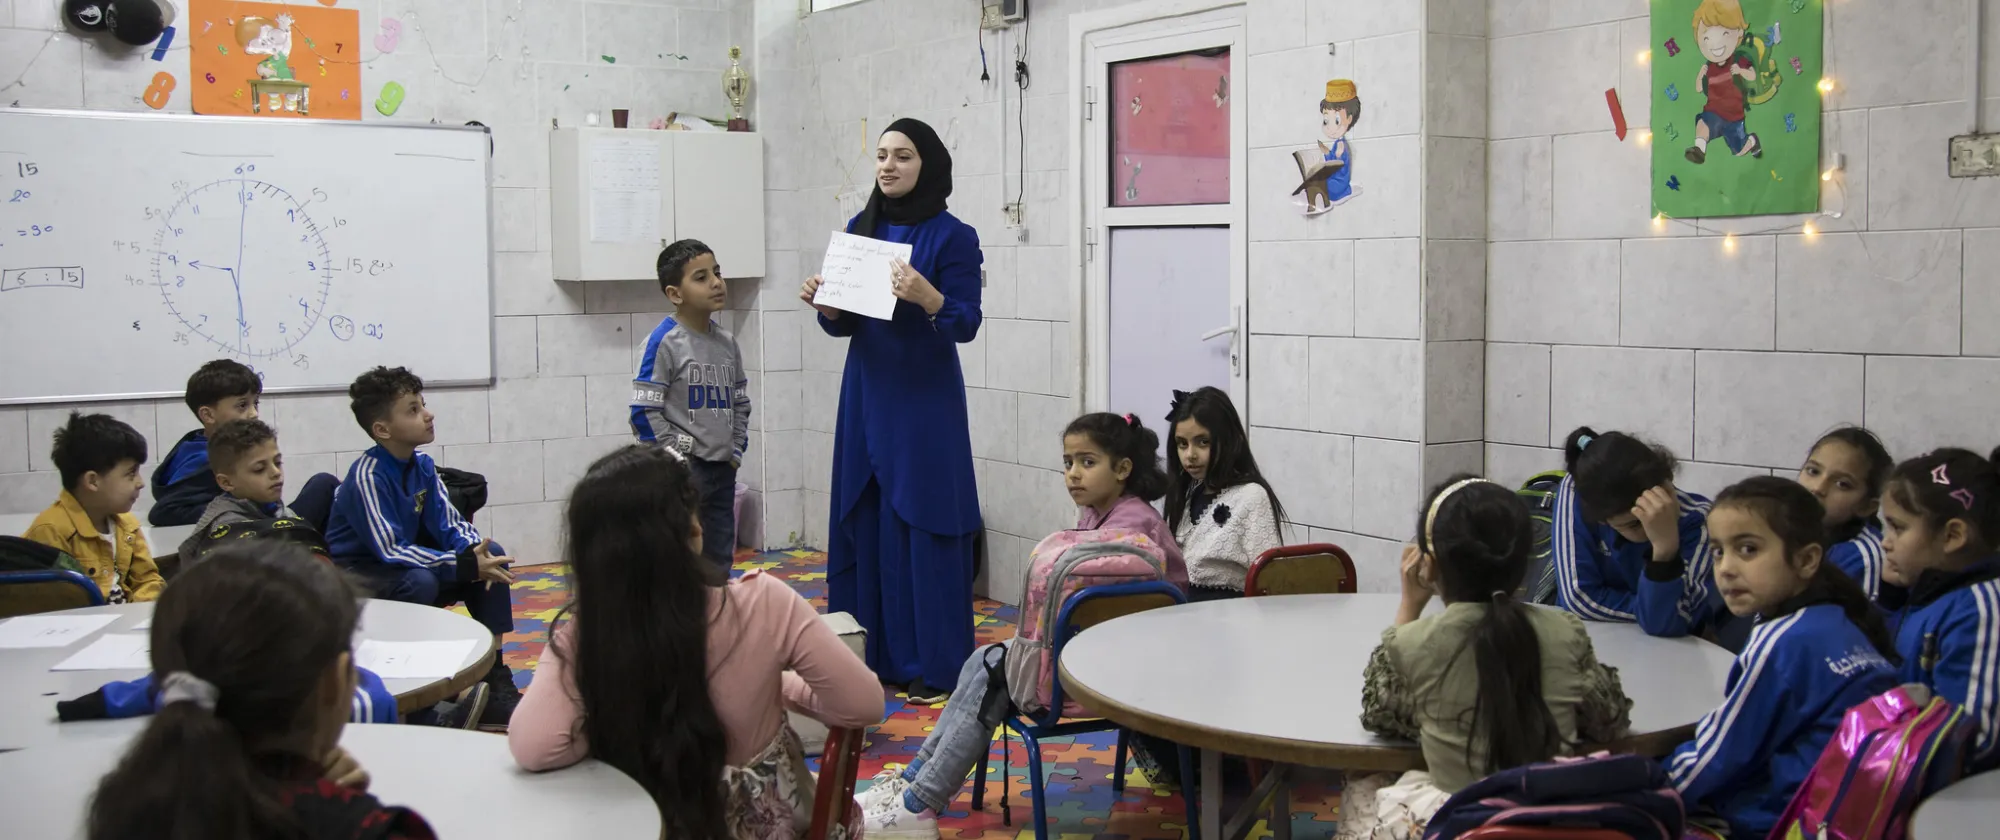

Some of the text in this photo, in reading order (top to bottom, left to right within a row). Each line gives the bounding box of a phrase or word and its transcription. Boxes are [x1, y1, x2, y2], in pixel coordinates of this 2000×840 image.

[335, 43, 343, 54] 7
[205, 72, 216, 84] 6
[143, 72, 176, 110] 8
[375, 81, 405, 116] 9
[18, 162, 38, 178] 15
[235, 163, 255, 175] 60
[9, 189, 31, 202] 20
[312, 187, 328, 203] 5
[333, 217, 347, 228] 10
[168, 254, 178, 266] 9
[308, 260, 316, 271] 3
[346, 257, 363, 273] 15
[125, 274, 144, 286] 40
[176, 276, 185, 288] 8
[299, 298, 309, 316] 4
[279, 323, 287, 334] 5
[173, 332, 189, 346] 35
[293, 354, 310, 371] 25
